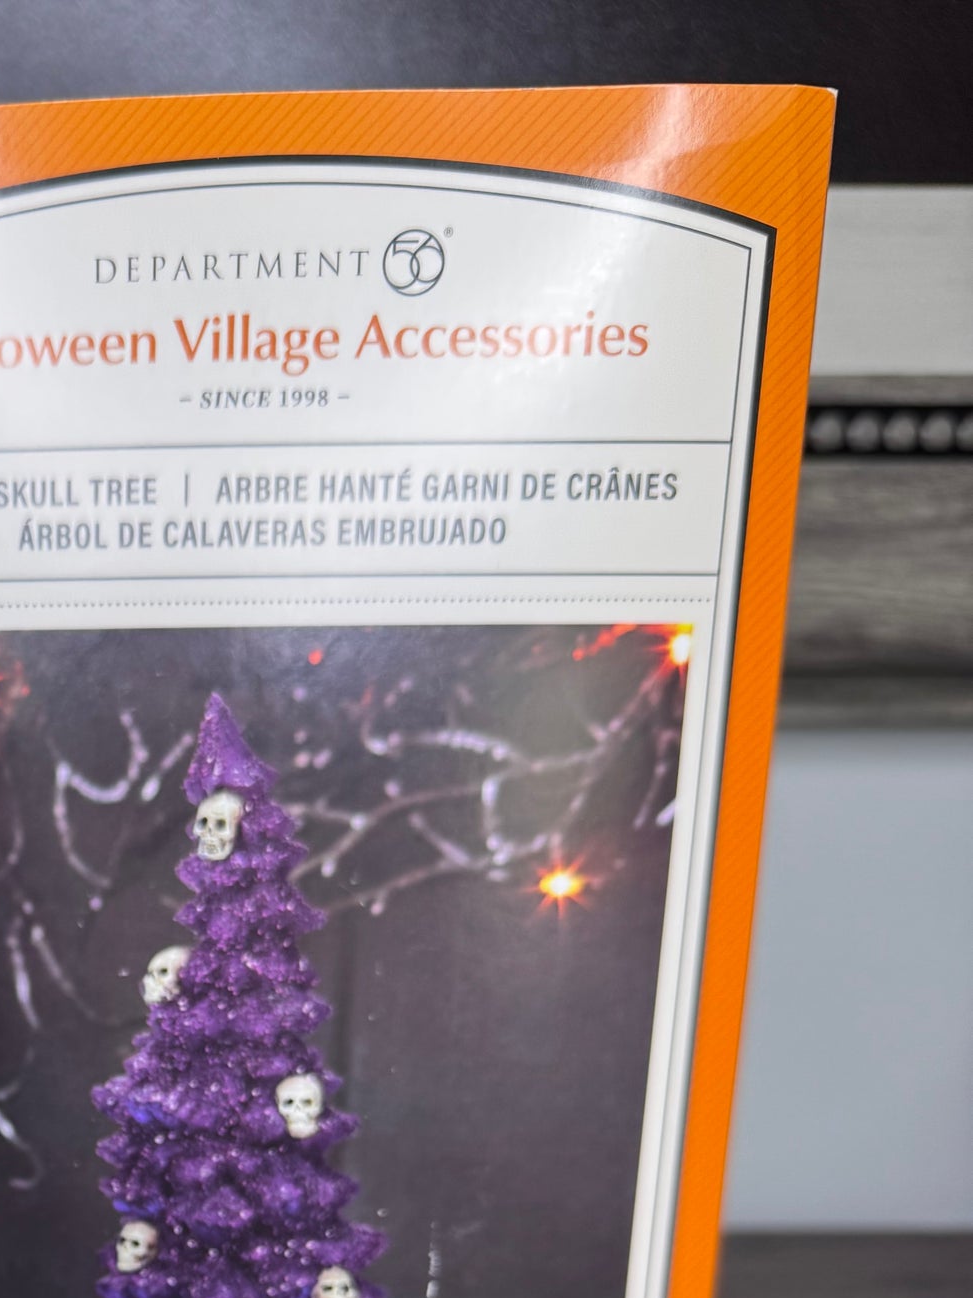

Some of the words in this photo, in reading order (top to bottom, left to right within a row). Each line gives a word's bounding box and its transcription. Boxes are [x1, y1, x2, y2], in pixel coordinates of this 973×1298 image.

[94, 250, 370, 285] DEPARTMENT
[173, 311, 340, 377] Village
[354, 310, 649, 360] Accessories
[199, 388, 271, 409] SINCE
[278, 388, 329, 408] 1998
[89, 476, 158, 507] TREE
[216, 474, 308, 505] ARBRE
[319, 468, 412, 503] HANTÉ
[421, 473, 509, 502] GARNI
[520, 472, 556, 501] DE
[566, 466, 679, 501] CRÂNES
[18, 518, 108, 551] ÁRBOL
[117, 521, 153, 549] DE
[162, 518, 327, 549] CALAVERAS
[336, 516, 507, 547] EMBRUJADO
